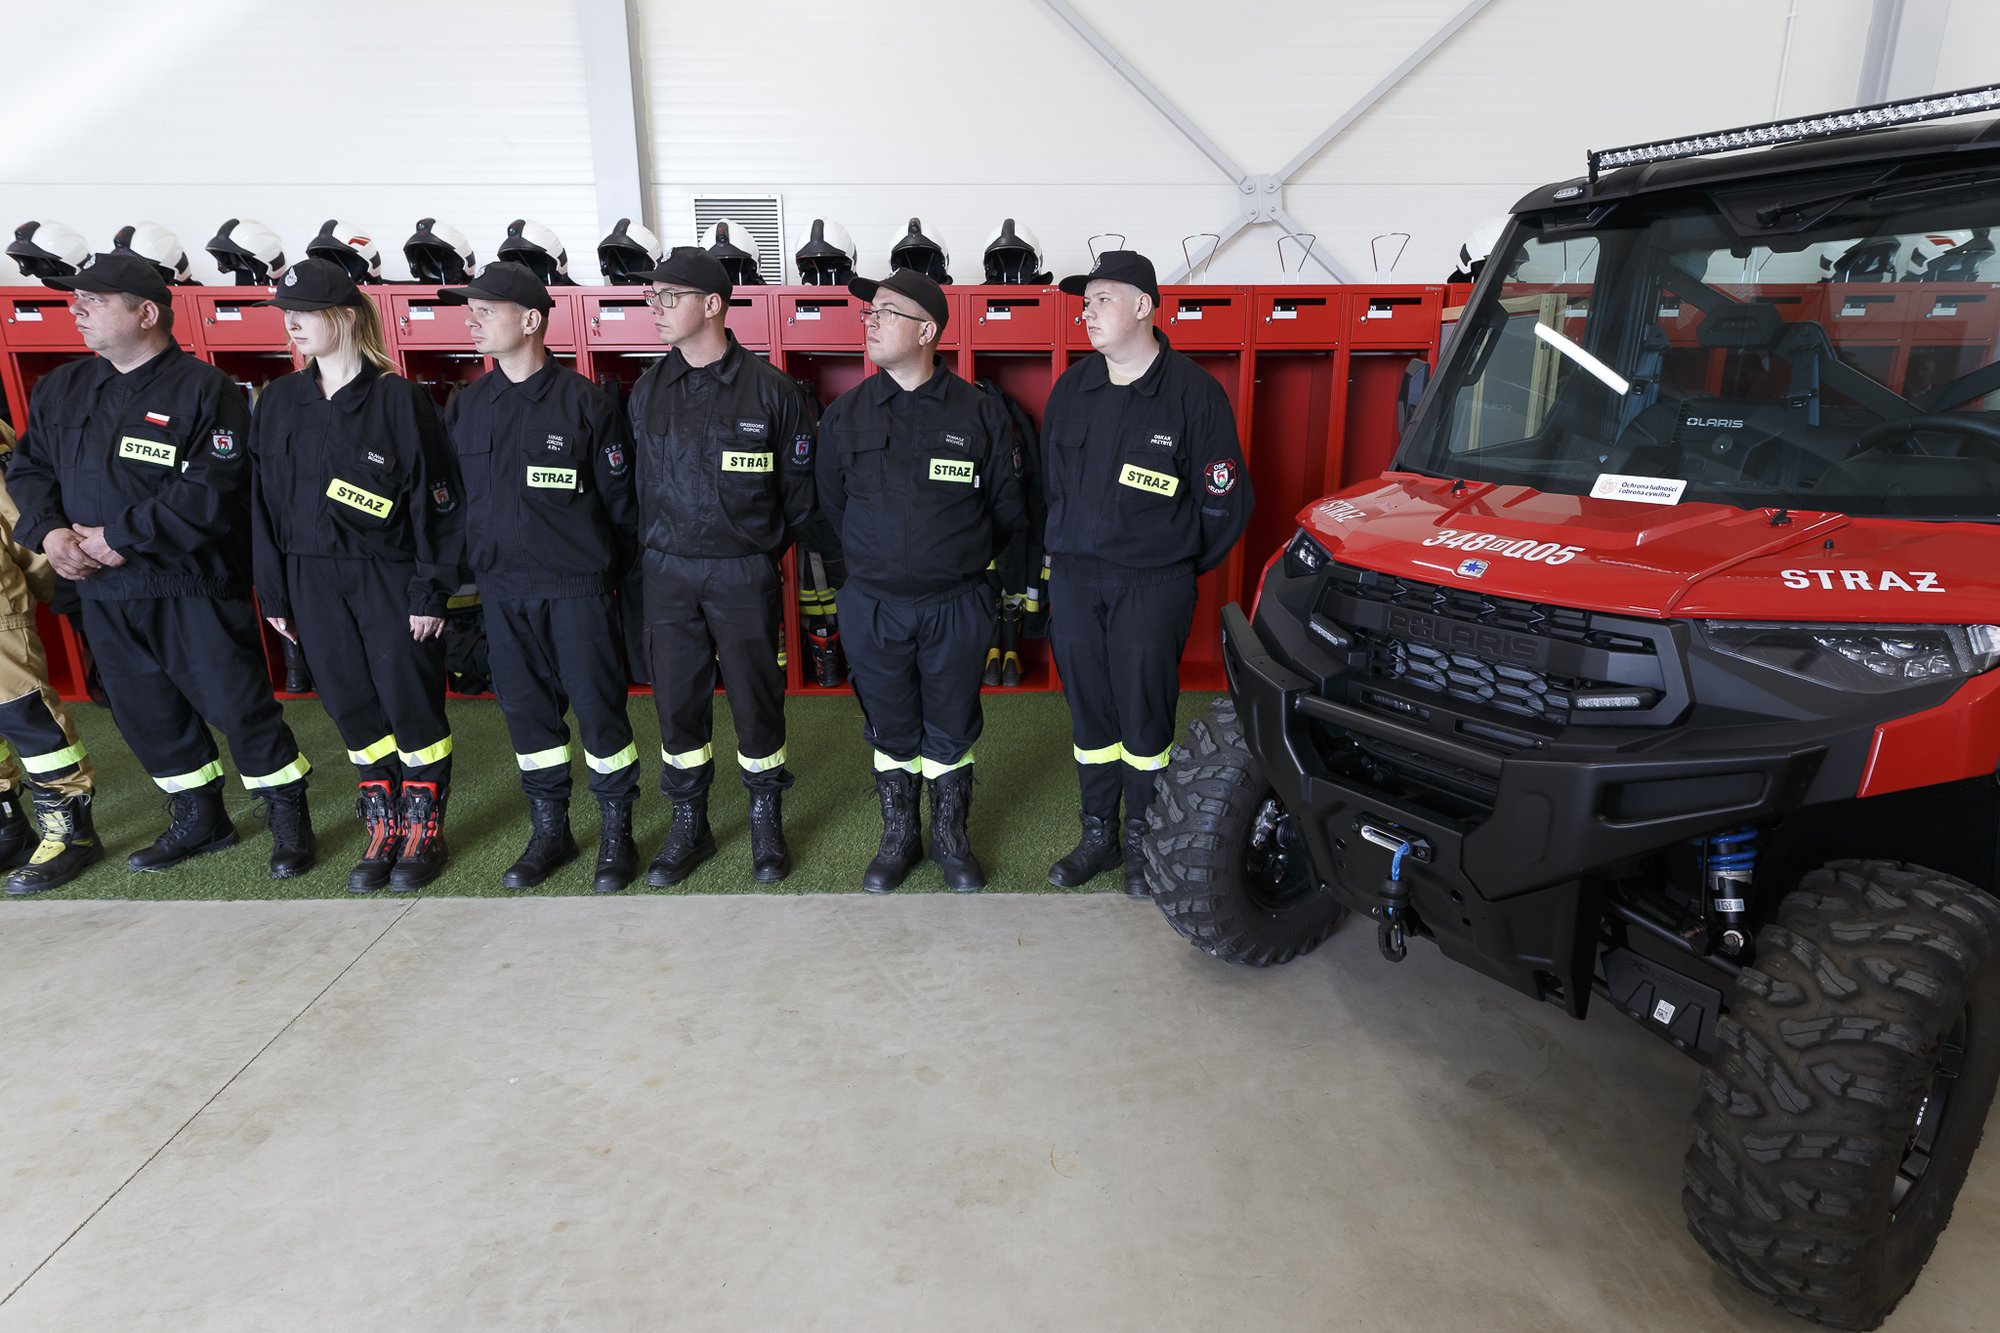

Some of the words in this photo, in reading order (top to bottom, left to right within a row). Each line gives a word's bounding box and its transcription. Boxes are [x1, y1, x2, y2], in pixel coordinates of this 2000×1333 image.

[1621, 481, 1649, 490] Ochrona
[1650, 484, 1678, 492] ludności
[1622, 488, 1645, 496] obrona
[1645, 490, 1671, 498] cywilna
[1387, 610, 1540, 663] POLARIS
